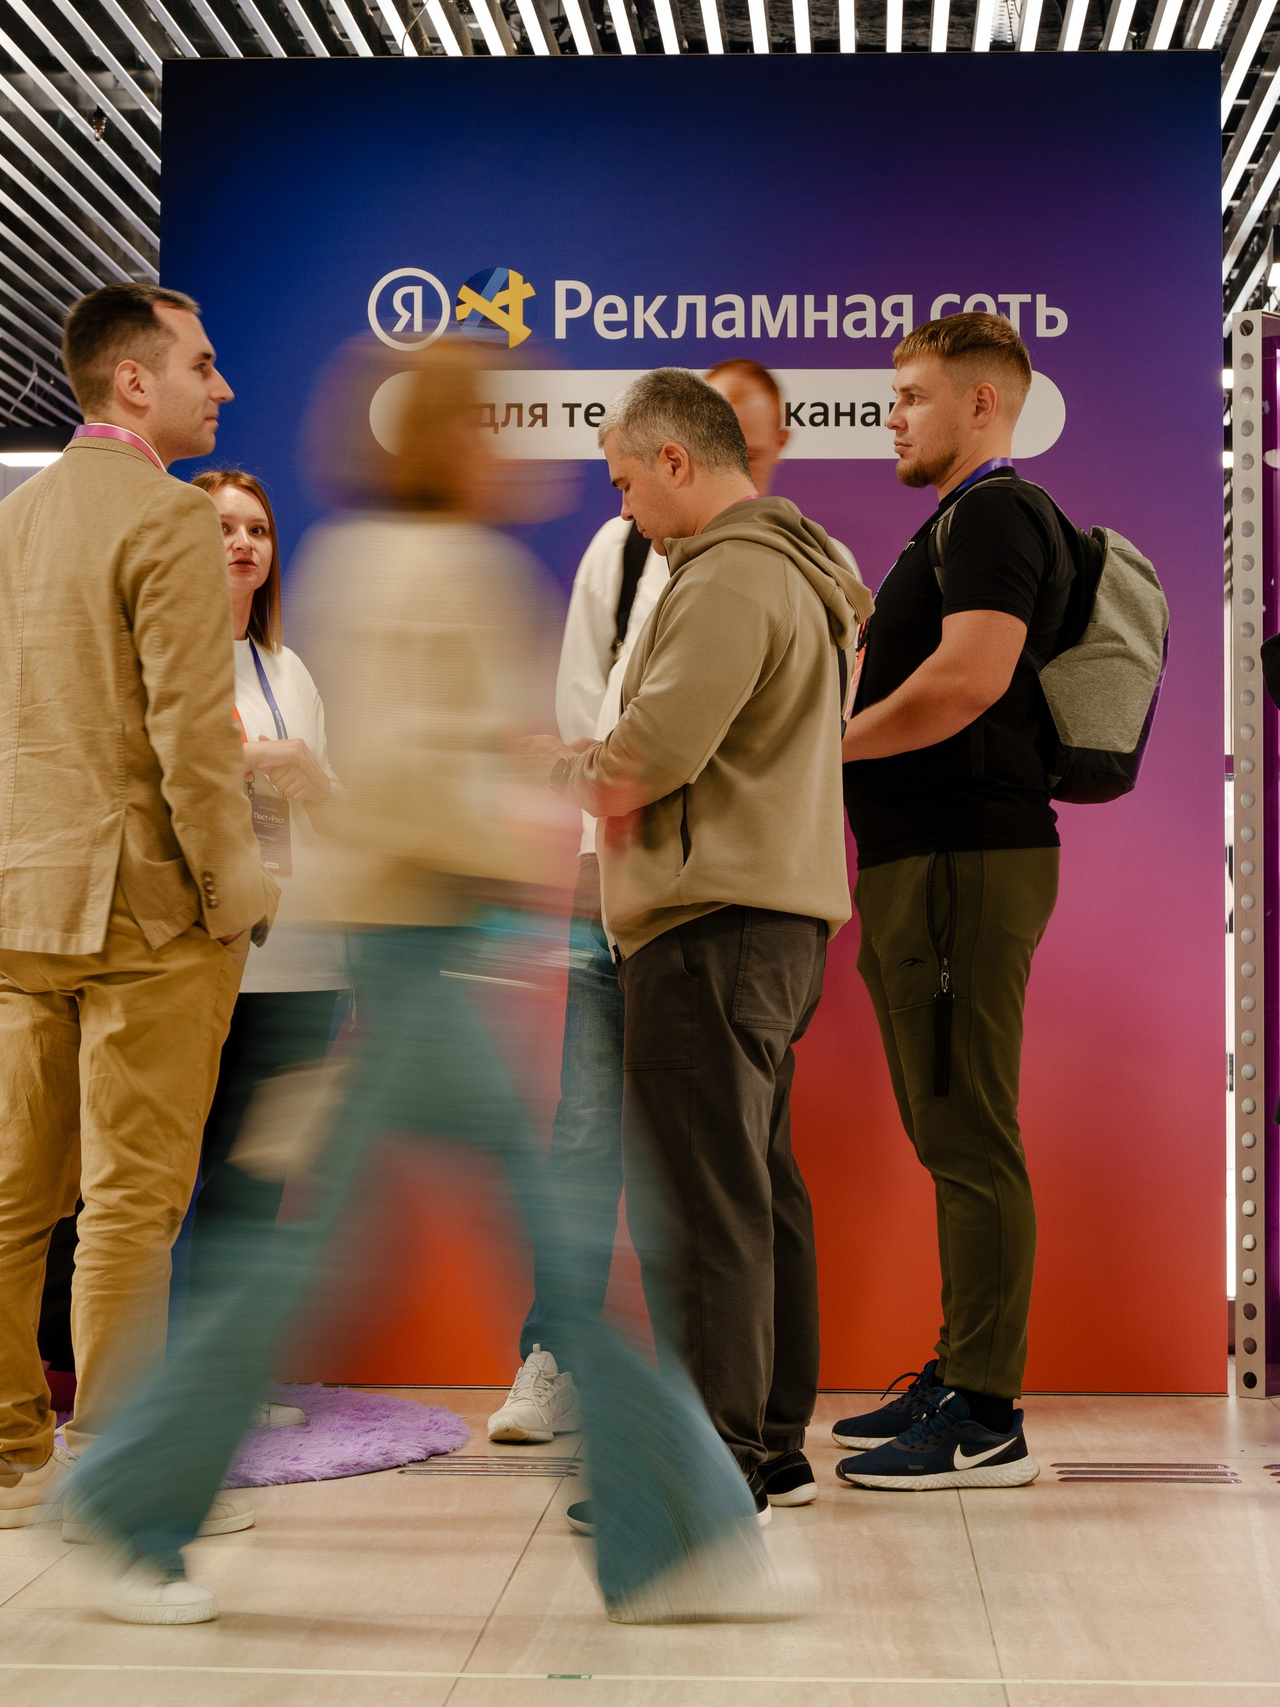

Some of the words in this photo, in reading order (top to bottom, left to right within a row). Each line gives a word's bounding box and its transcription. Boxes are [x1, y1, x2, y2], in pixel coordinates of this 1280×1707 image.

[554, 279, 914, 340] Рекламная
[478, 402, 548, 435] для
[785, 401, 896, 428] кана
